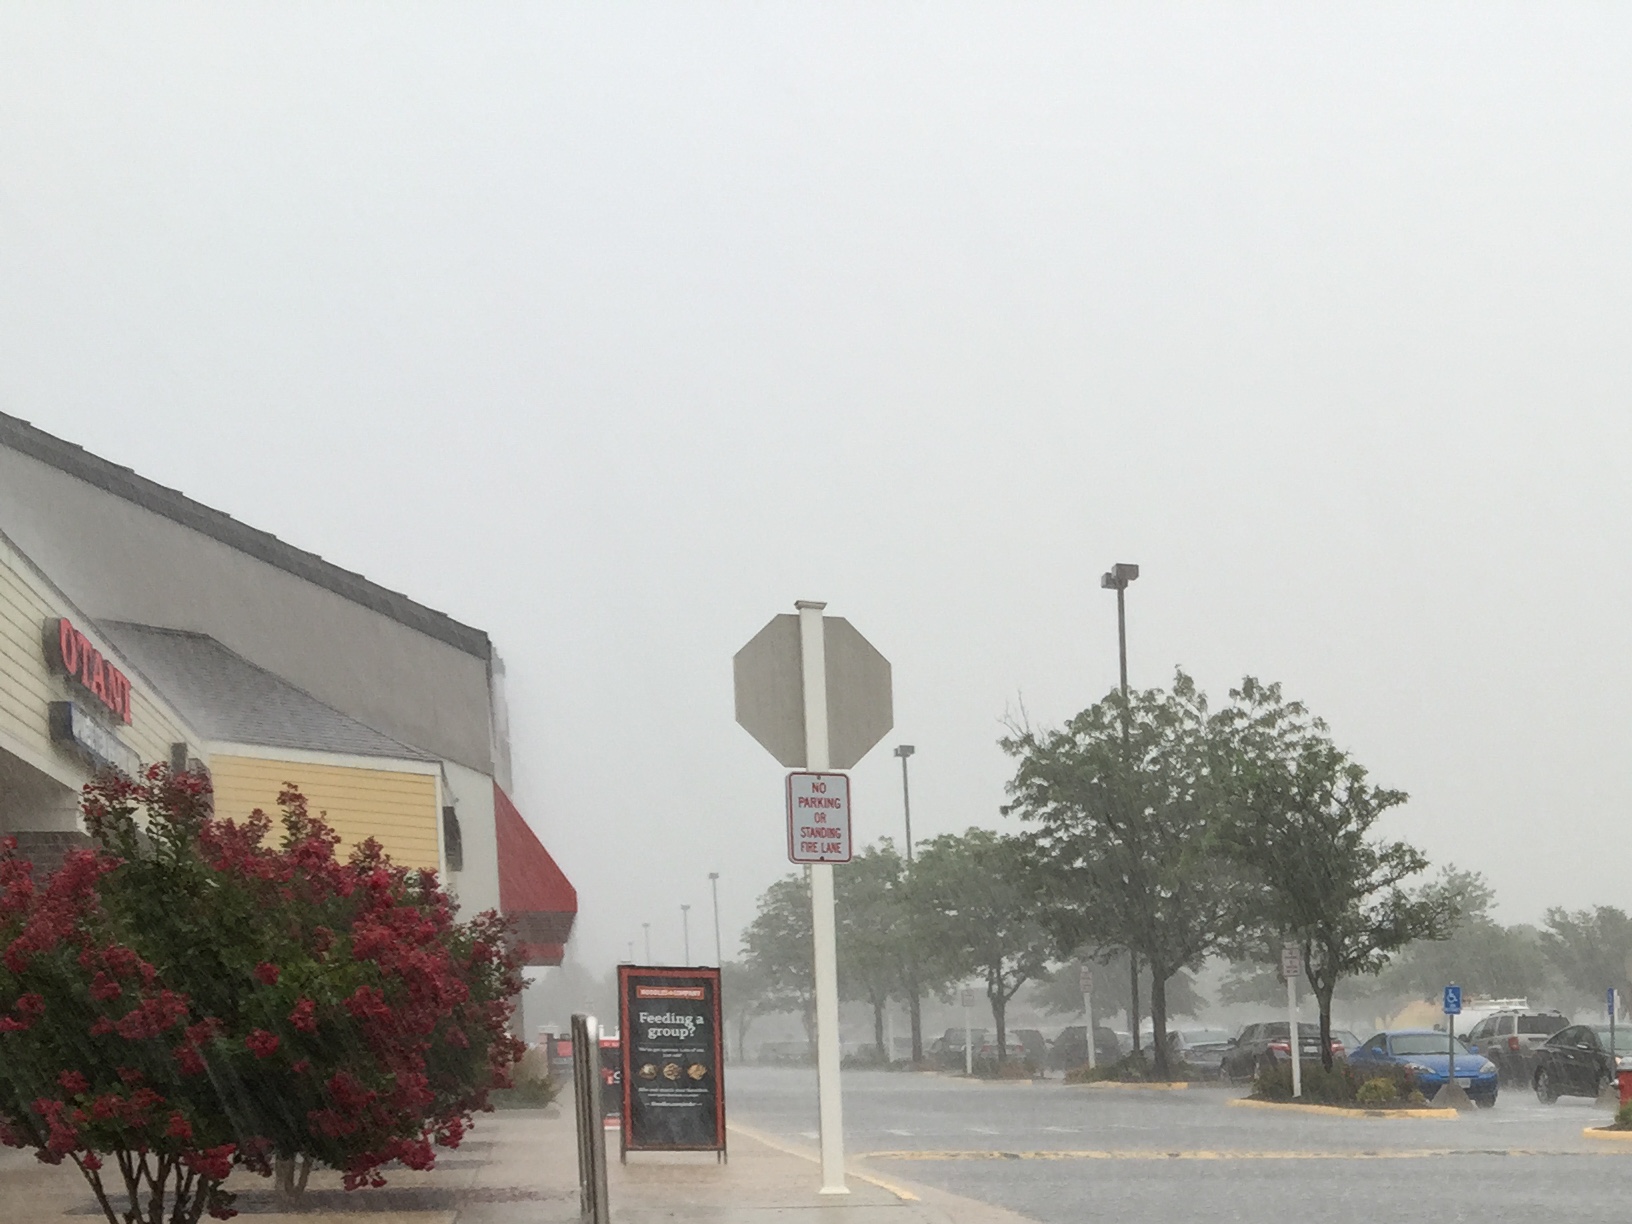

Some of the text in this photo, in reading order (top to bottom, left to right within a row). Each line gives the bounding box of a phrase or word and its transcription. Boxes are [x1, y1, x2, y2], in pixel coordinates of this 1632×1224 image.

[59, 617, 132, 726] OTANI
[811, 782, 827, 794] NO
[798, 797, 841, 809] PARKING
[814, 812, 827, 823] OR
[800, 826, 841, 839] STANDING
[800, 841, 841, 854] FIRE LANE
[639, 1011, 704, 1028] Feeding a
[647, 1025, 696, 1040] group?
